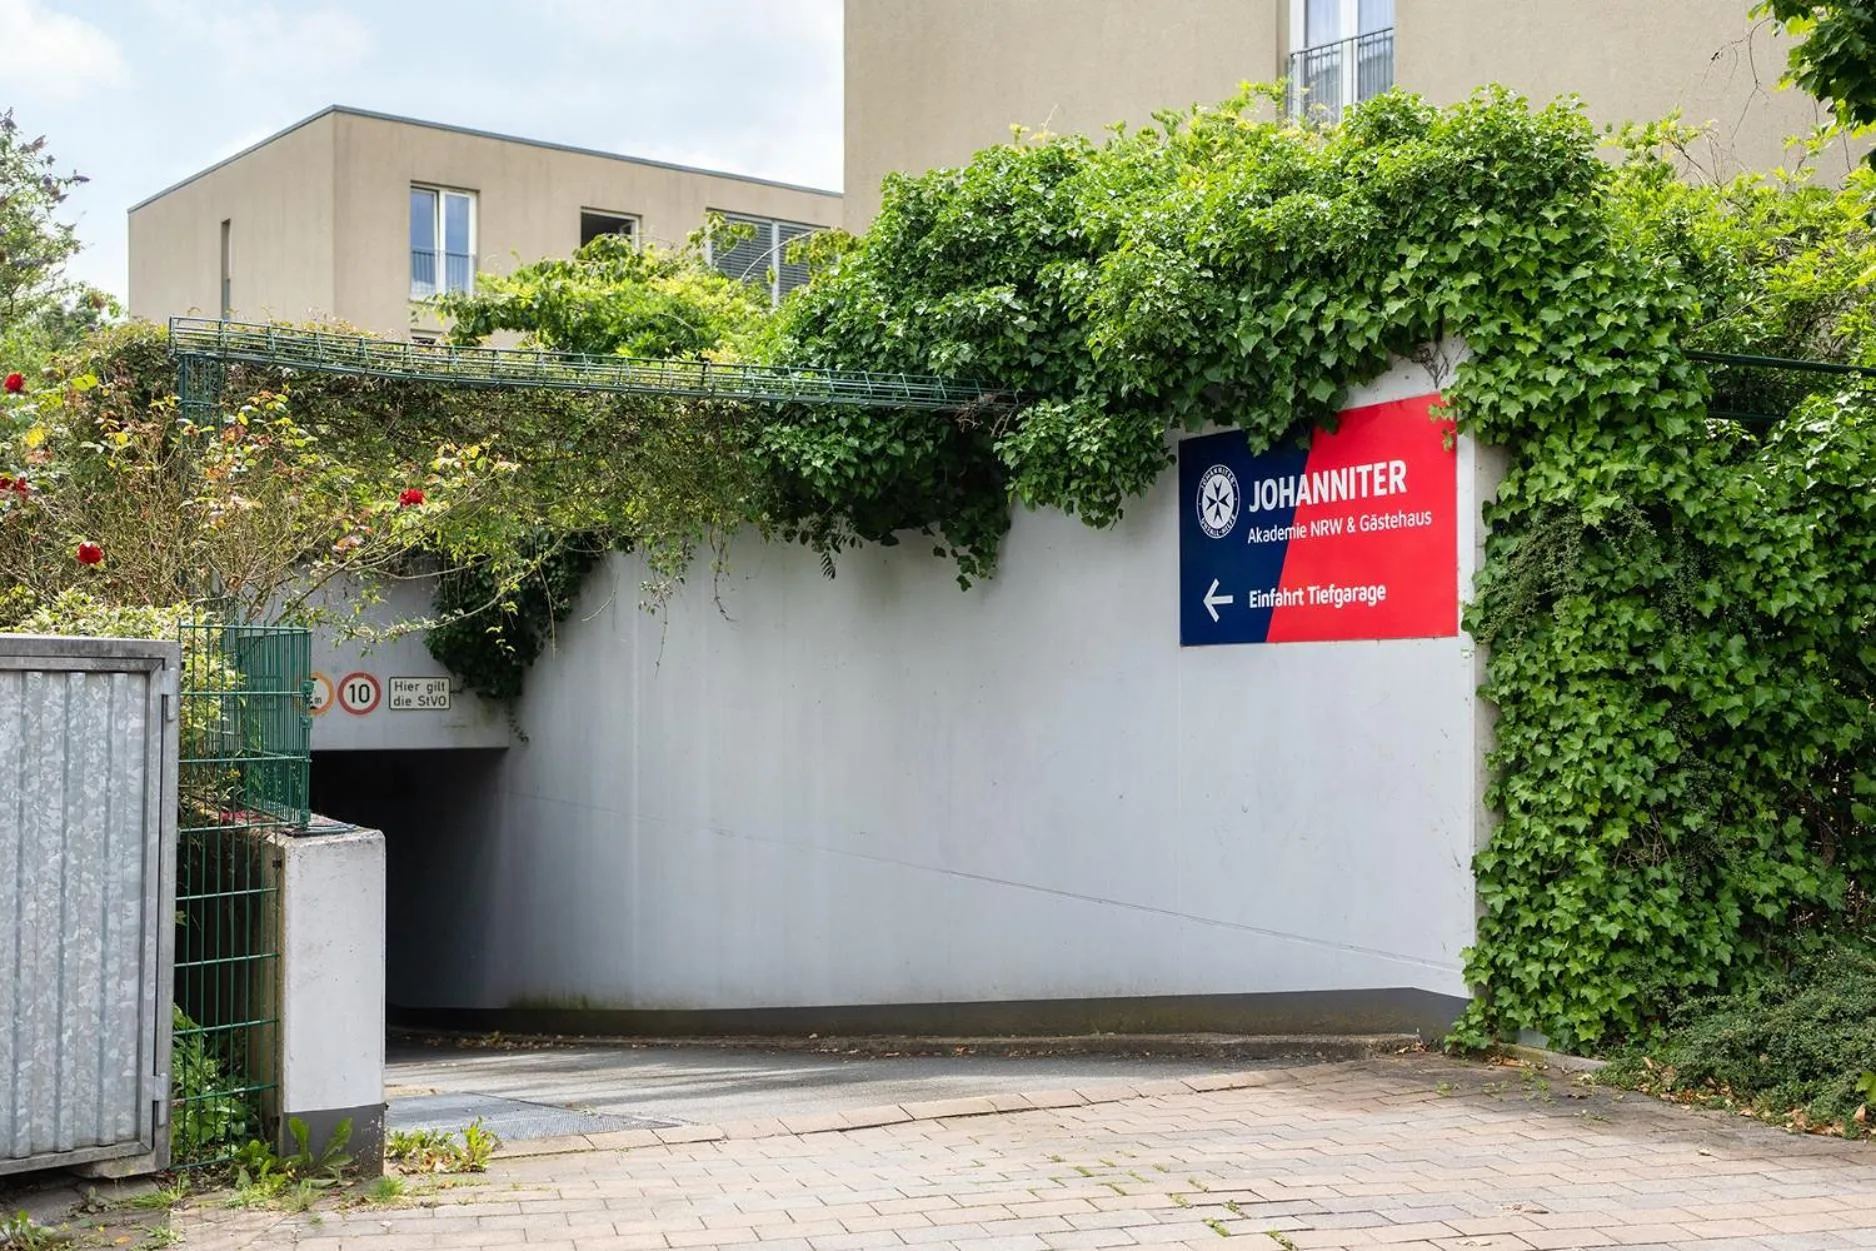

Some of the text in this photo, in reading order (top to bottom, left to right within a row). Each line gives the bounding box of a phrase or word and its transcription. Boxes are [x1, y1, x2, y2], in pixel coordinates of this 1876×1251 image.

[1249, 459, 1407, 513] JOHANNITER
[1248, 523, 1307, 544] Akademie
[1310, 517, 1343, 537] NRW
[1346, 514, 1356, 533] &
[1359, 510, 1432, 531] Gästehaus
[1249, 584, 1387, 609] Einfahrt Tiefgarage
[349, 683, 370, 704] 10
[394, 681, 445, 695] Hier gilt
[393, 695, 447, 707] die StVO
